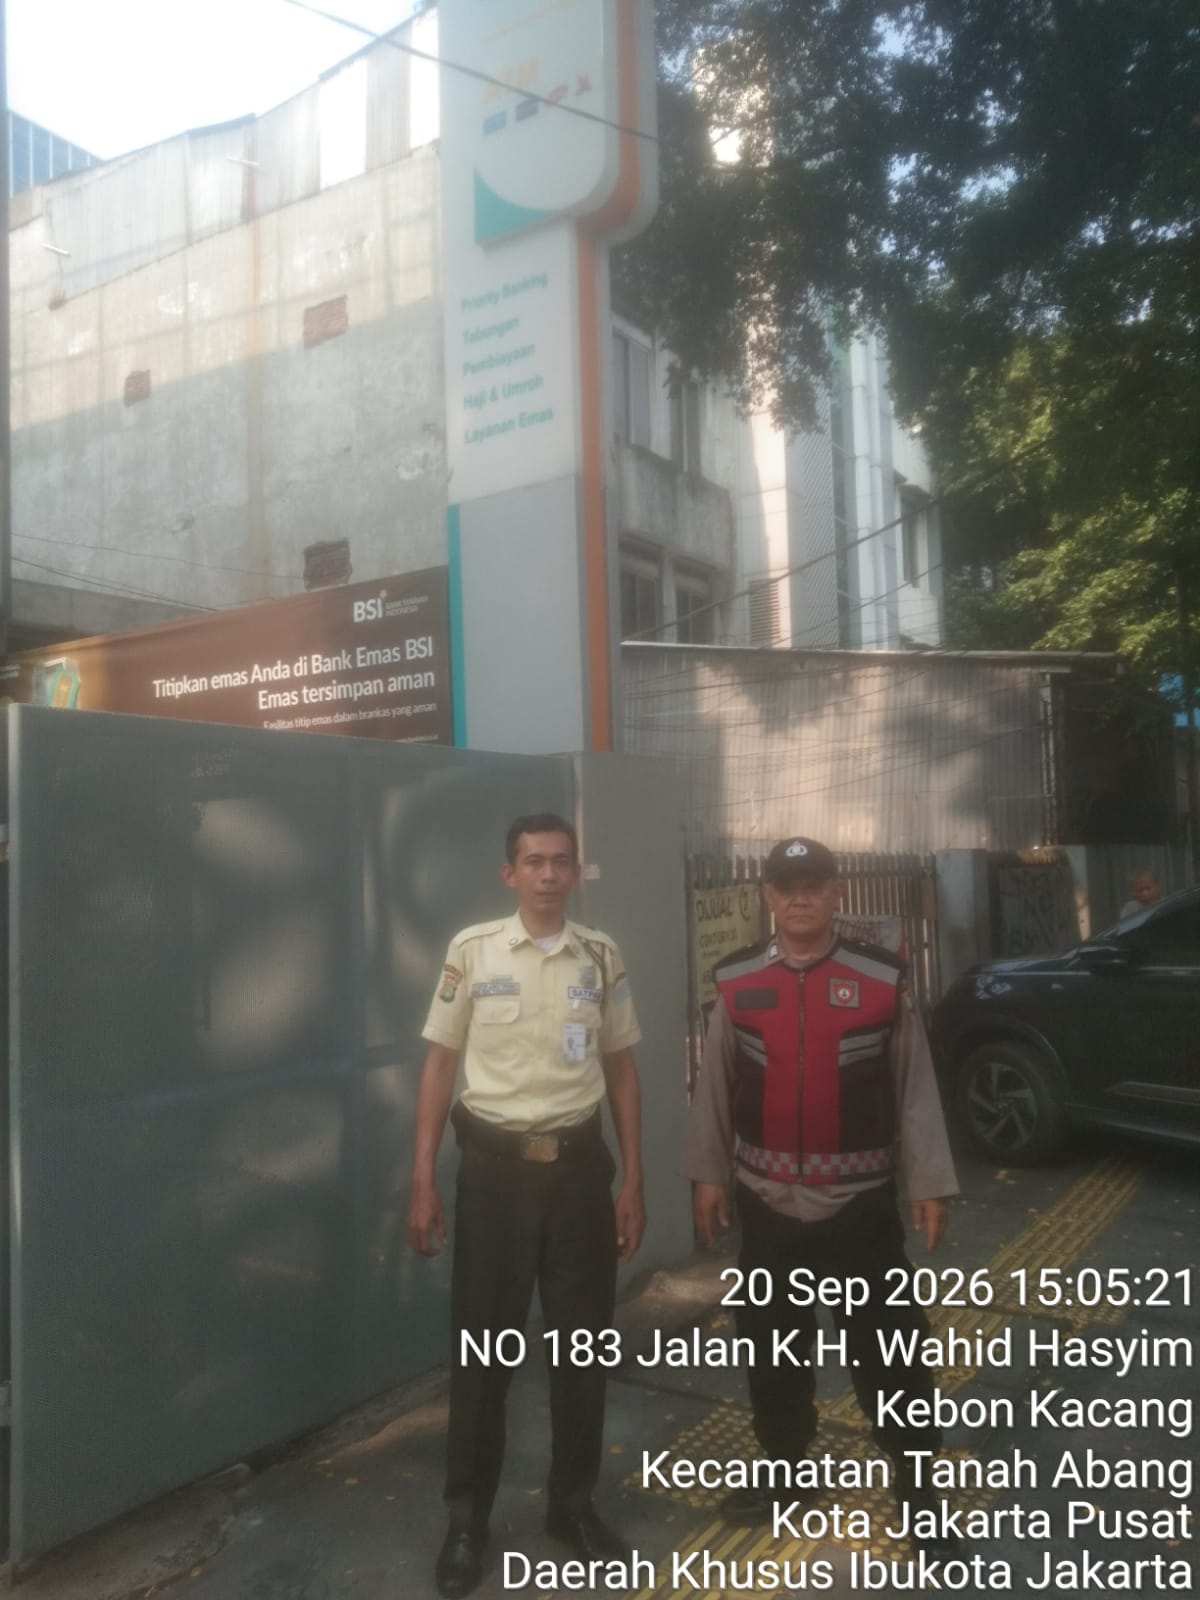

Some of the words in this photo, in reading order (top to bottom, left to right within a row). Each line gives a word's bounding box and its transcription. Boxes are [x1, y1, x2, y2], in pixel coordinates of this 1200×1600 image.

[353, 597, 383, 623] BSI
[152, 675, 208, 699] Titipkan
[211, 670, 248, 689] emas
[250, 660, 290, 684] Anda
[294, 655, 308, 677] di
[311, 649, 353, 675] Bank
[356, 646, 401, 668] Emas
[405, 636, 434, 660] BSI
[258, 690, 299, 710] Emas
[302, 679, 384, 704] tersimpan
[387, 671, 436, 693] aman
